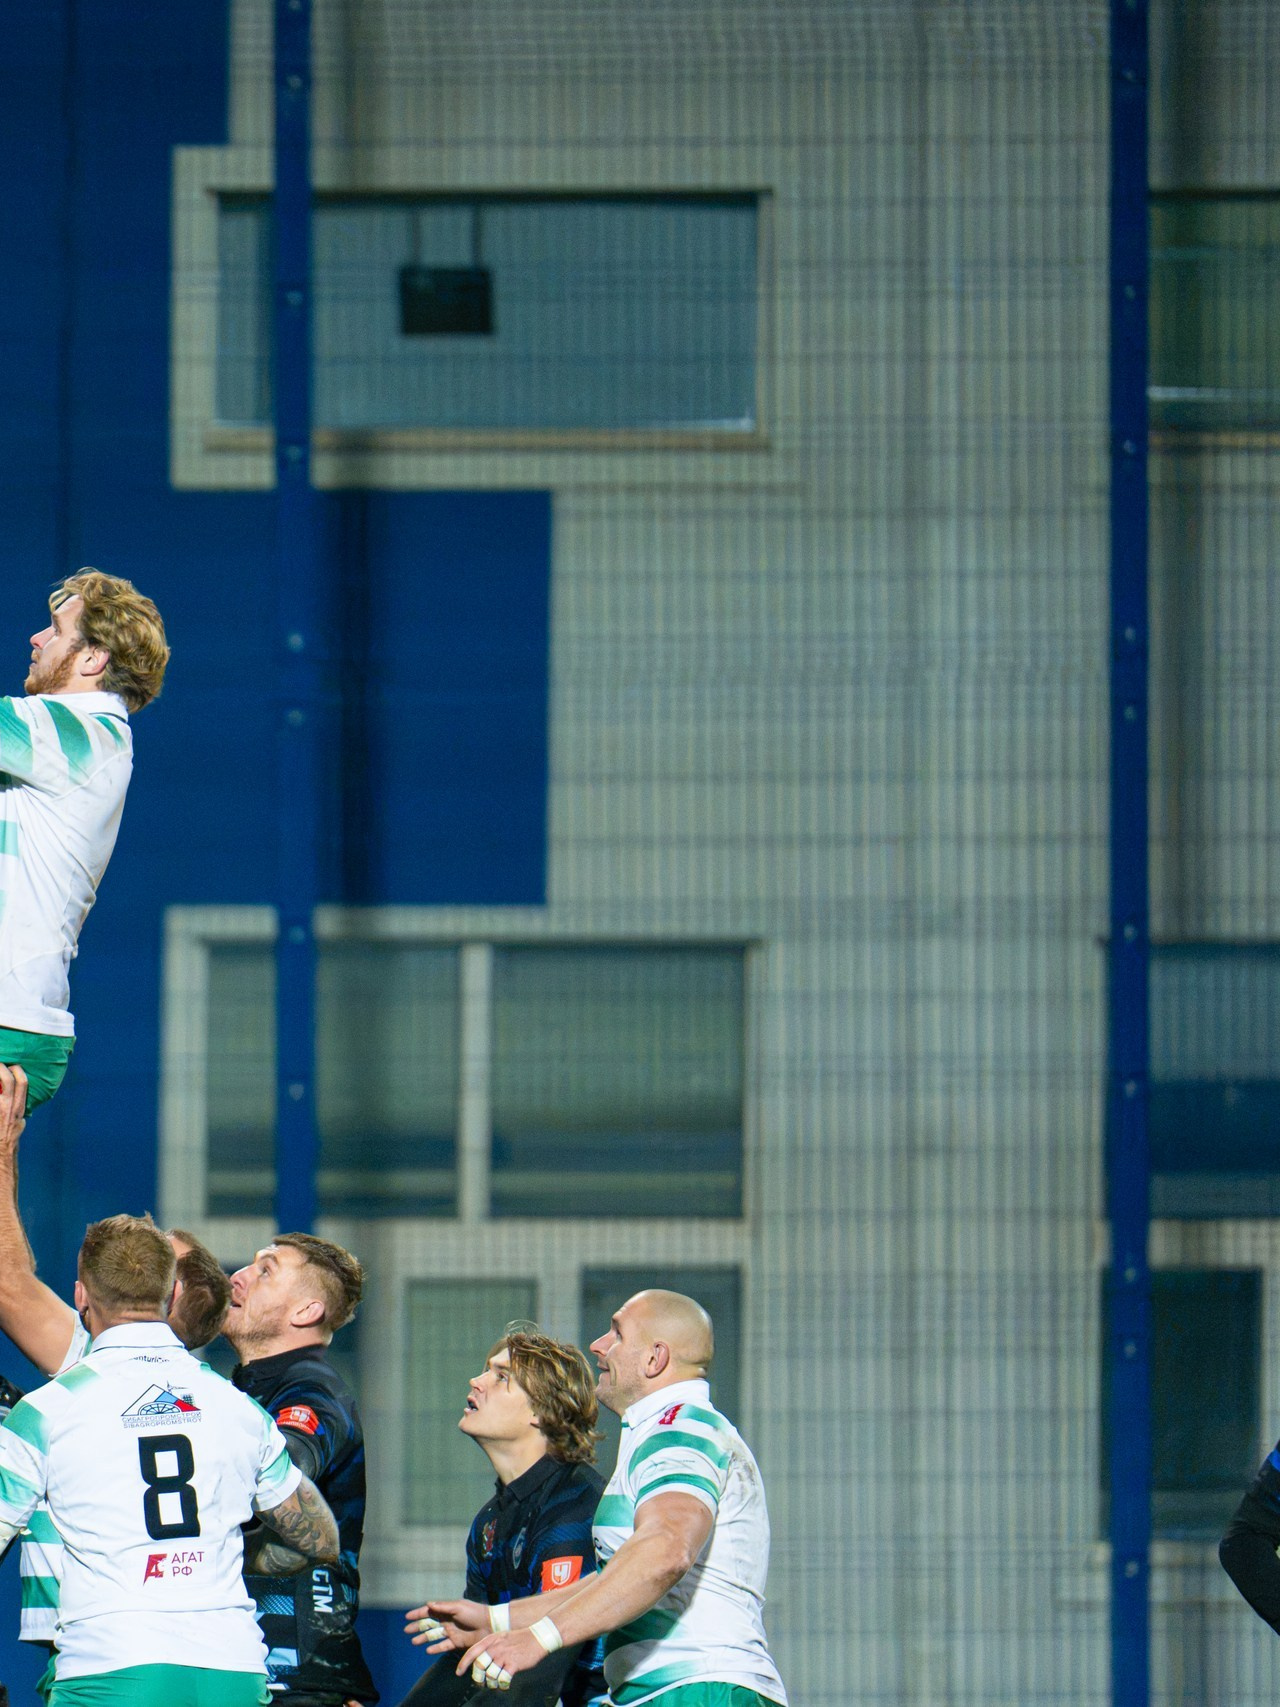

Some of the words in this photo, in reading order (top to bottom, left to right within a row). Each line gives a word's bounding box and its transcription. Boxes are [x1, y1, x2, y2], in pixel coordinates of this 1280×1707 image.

[123, 1418, 202, 1429] SIBAGROPROMSTROY
[138, 1434, 201, 1541] 8
[171, 1551, 205, 1565] АГАТ
[172, 1565, 193, 1577] РФ
